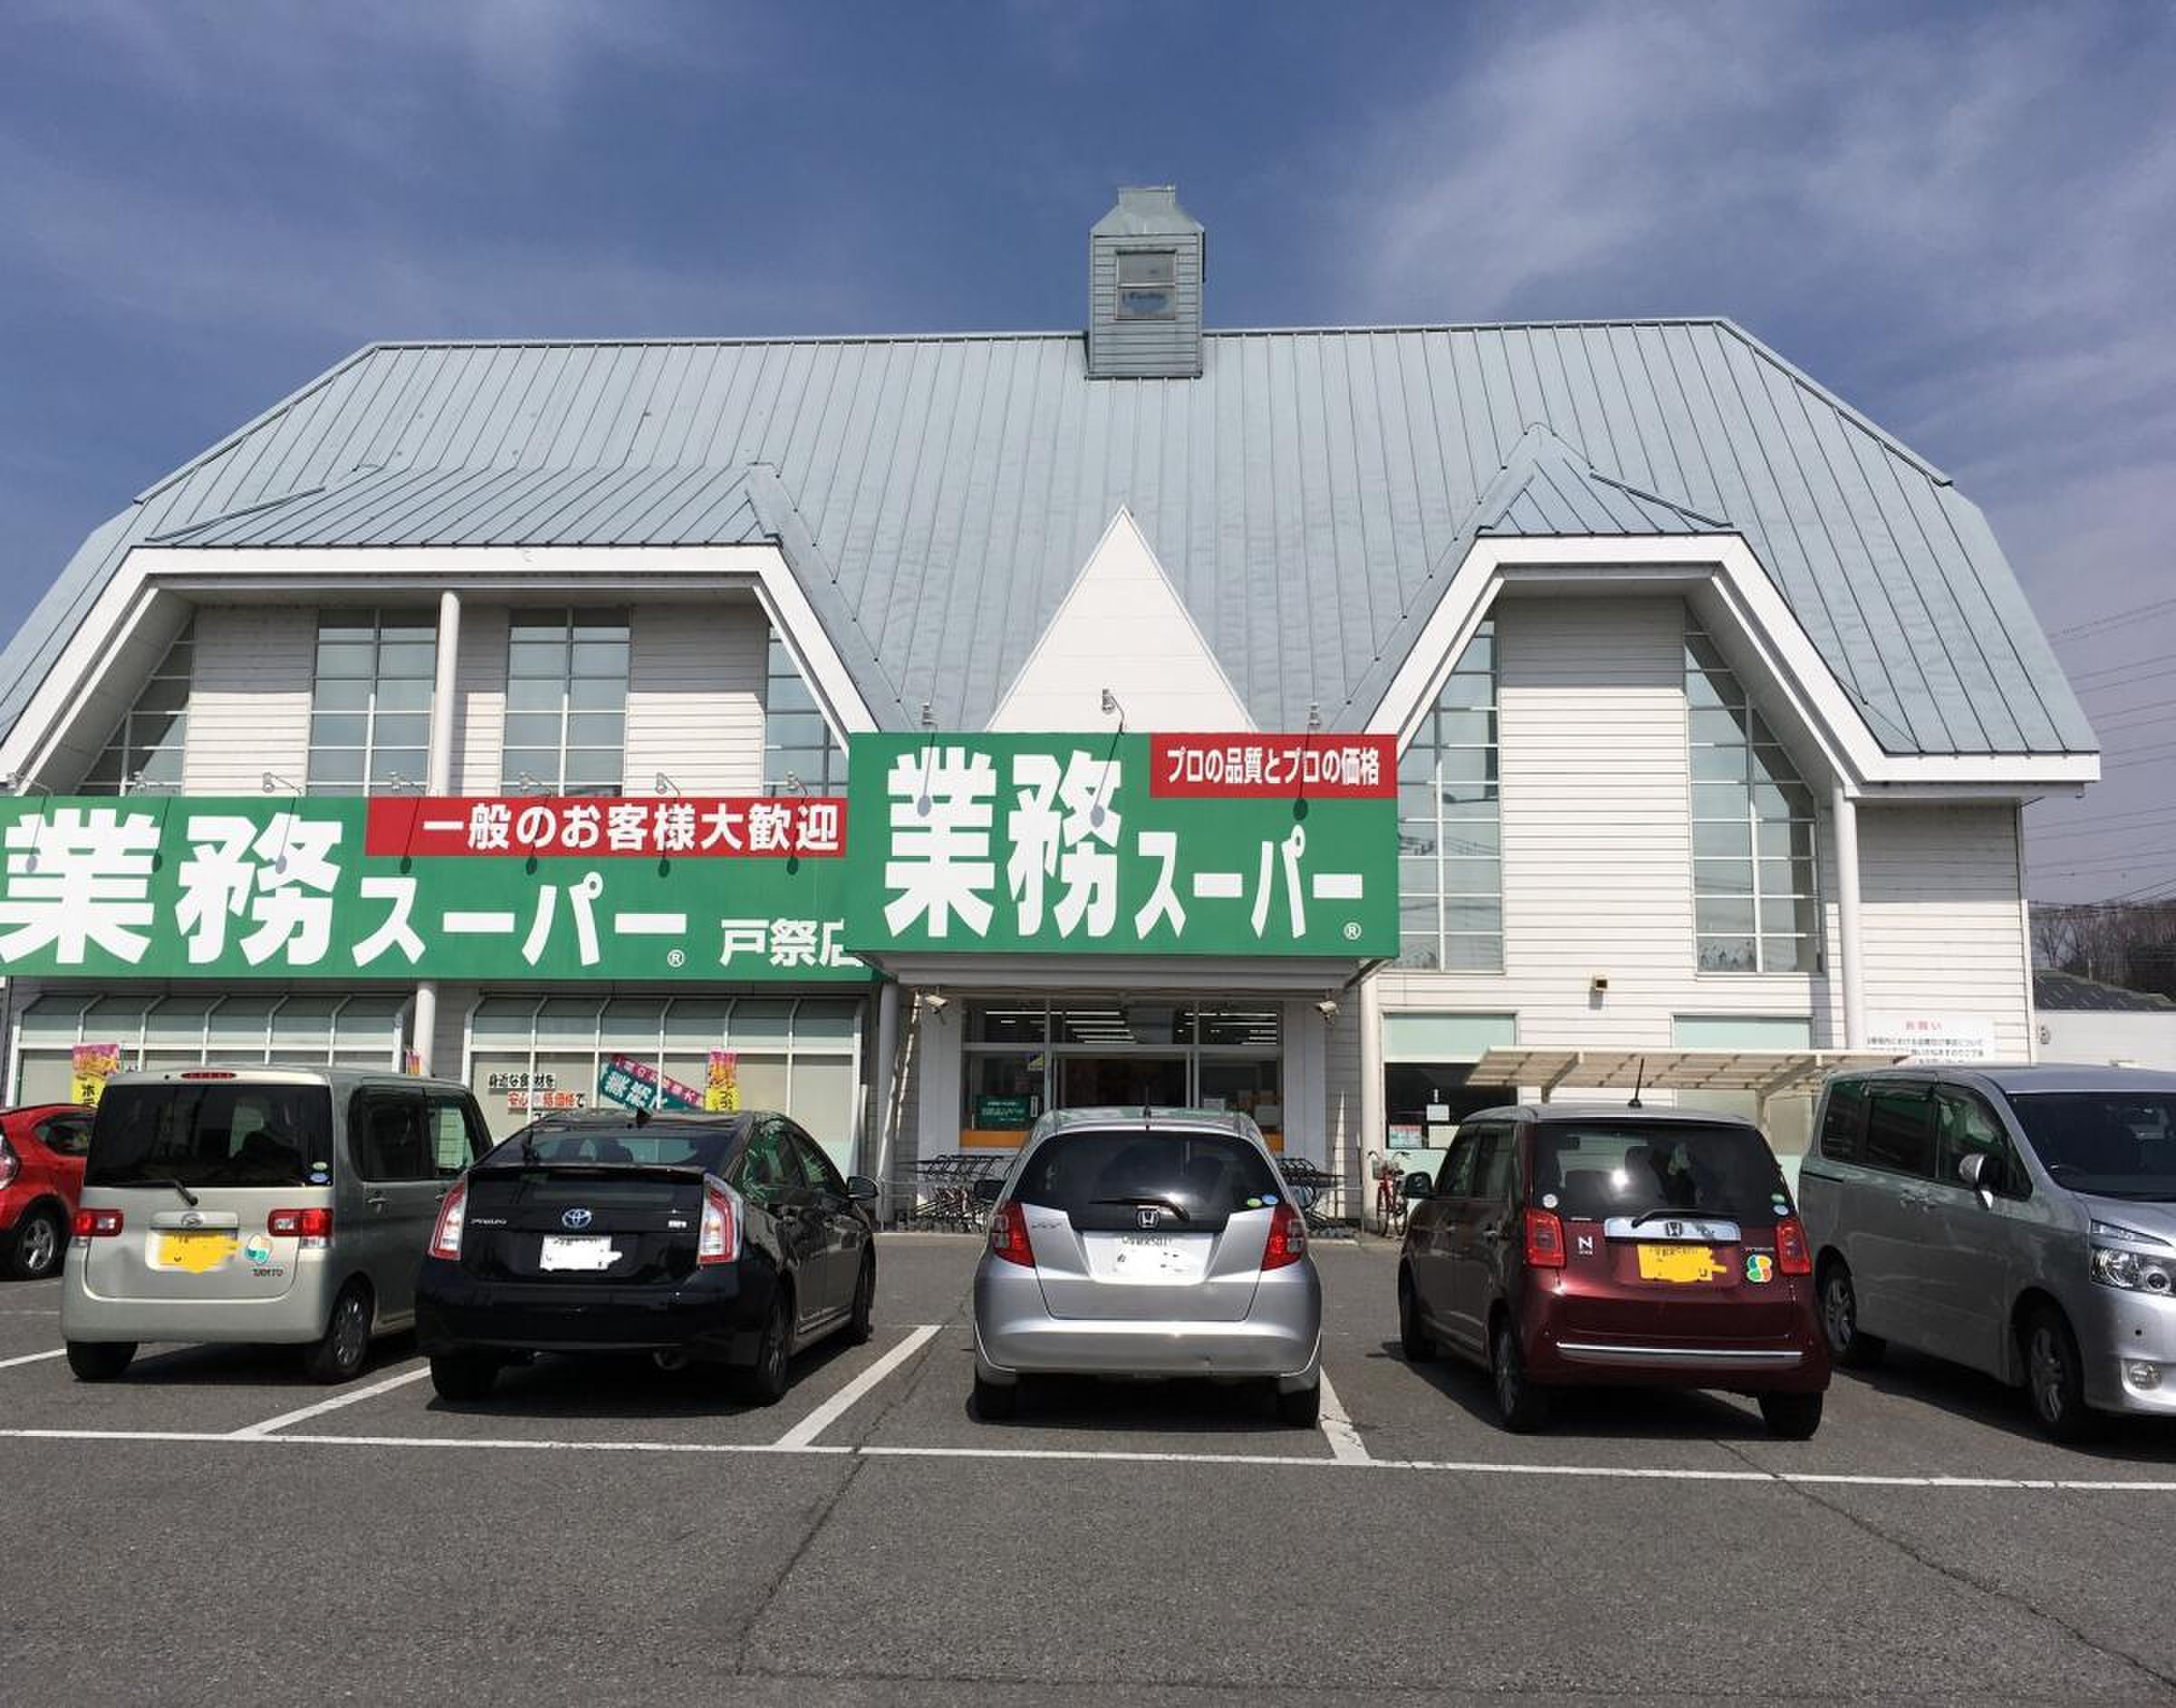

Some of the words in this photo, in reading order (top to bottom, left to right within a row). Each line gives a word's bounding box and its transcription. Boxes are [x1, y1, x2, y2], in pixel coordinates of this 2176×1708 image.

[1167, 746, 1380, 786] プロの品質とプロの価格
[423, 802, 840, 852] 一般のお客様大歓迎
[884, 746, 1364, 939] 業務スーパー
[0, 808, 687, 967] 業務スーパー
